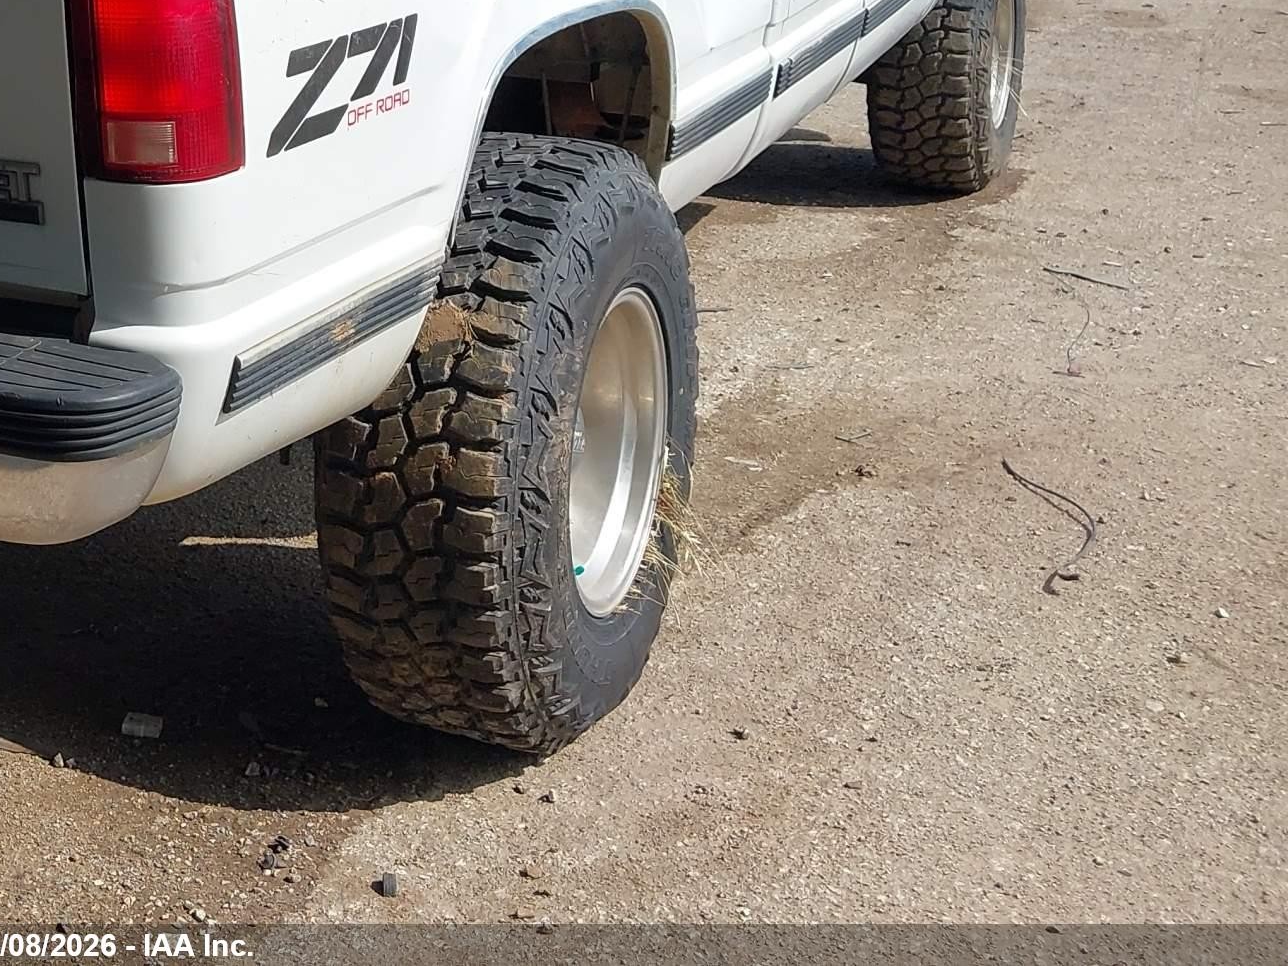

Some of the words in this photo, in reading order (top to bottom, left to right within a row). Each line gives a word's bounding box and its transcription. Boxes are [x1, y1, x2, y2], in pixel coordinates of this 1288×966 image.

[266, 13, 418, 158] Z71
[347, 103, 373, 127] OFF
[376, 88, 410, 116] ROAD
